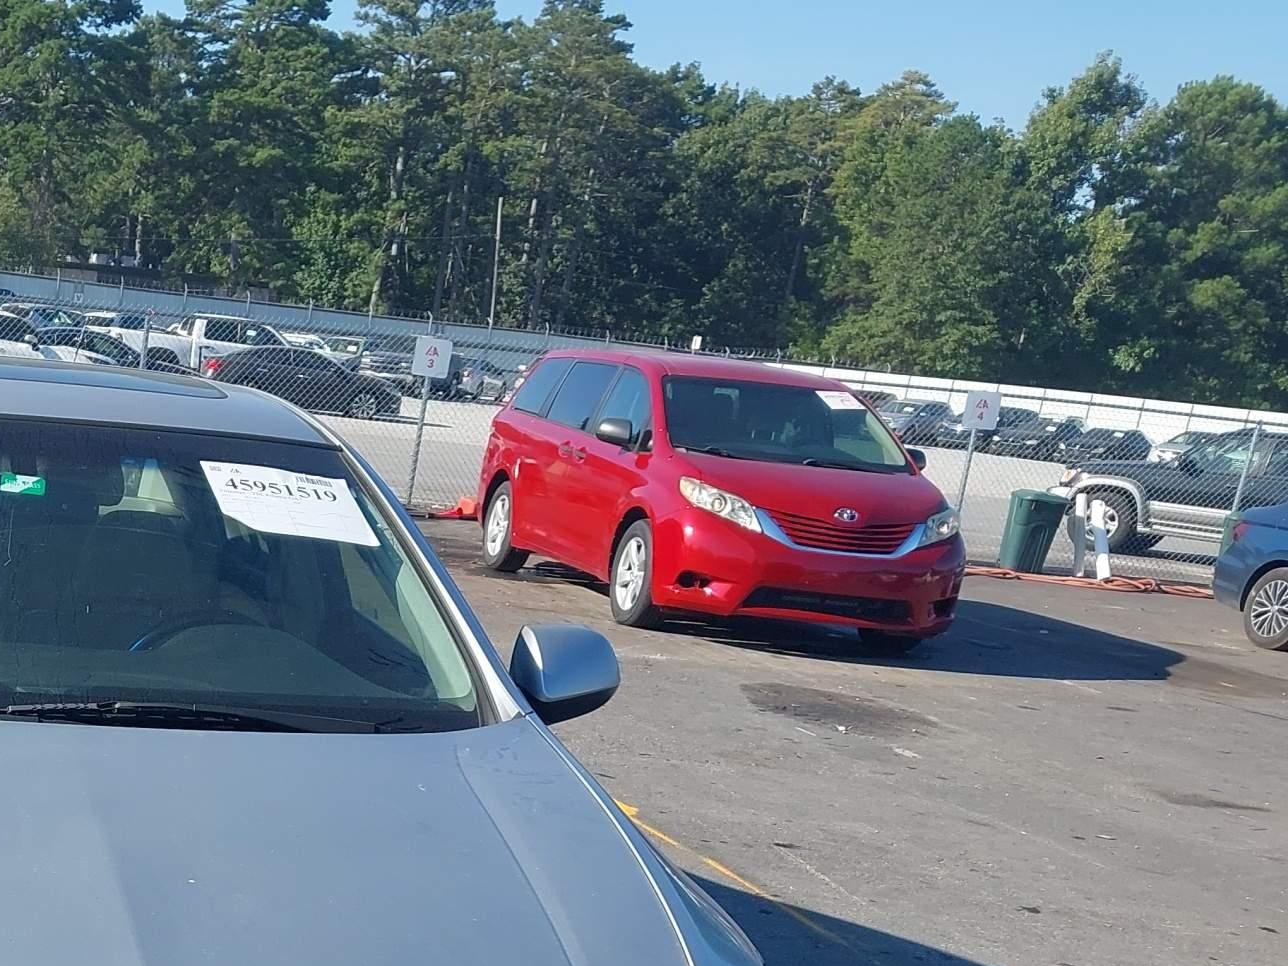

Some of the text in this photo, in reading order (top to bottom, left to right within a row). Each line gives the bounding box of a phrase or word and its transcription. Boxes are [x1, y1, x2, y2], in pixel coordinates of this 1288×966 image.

[427, 358, 434, 369] 3
[977, 411, 984, 421] 4
[225, 477, 338, 503] 45951519
